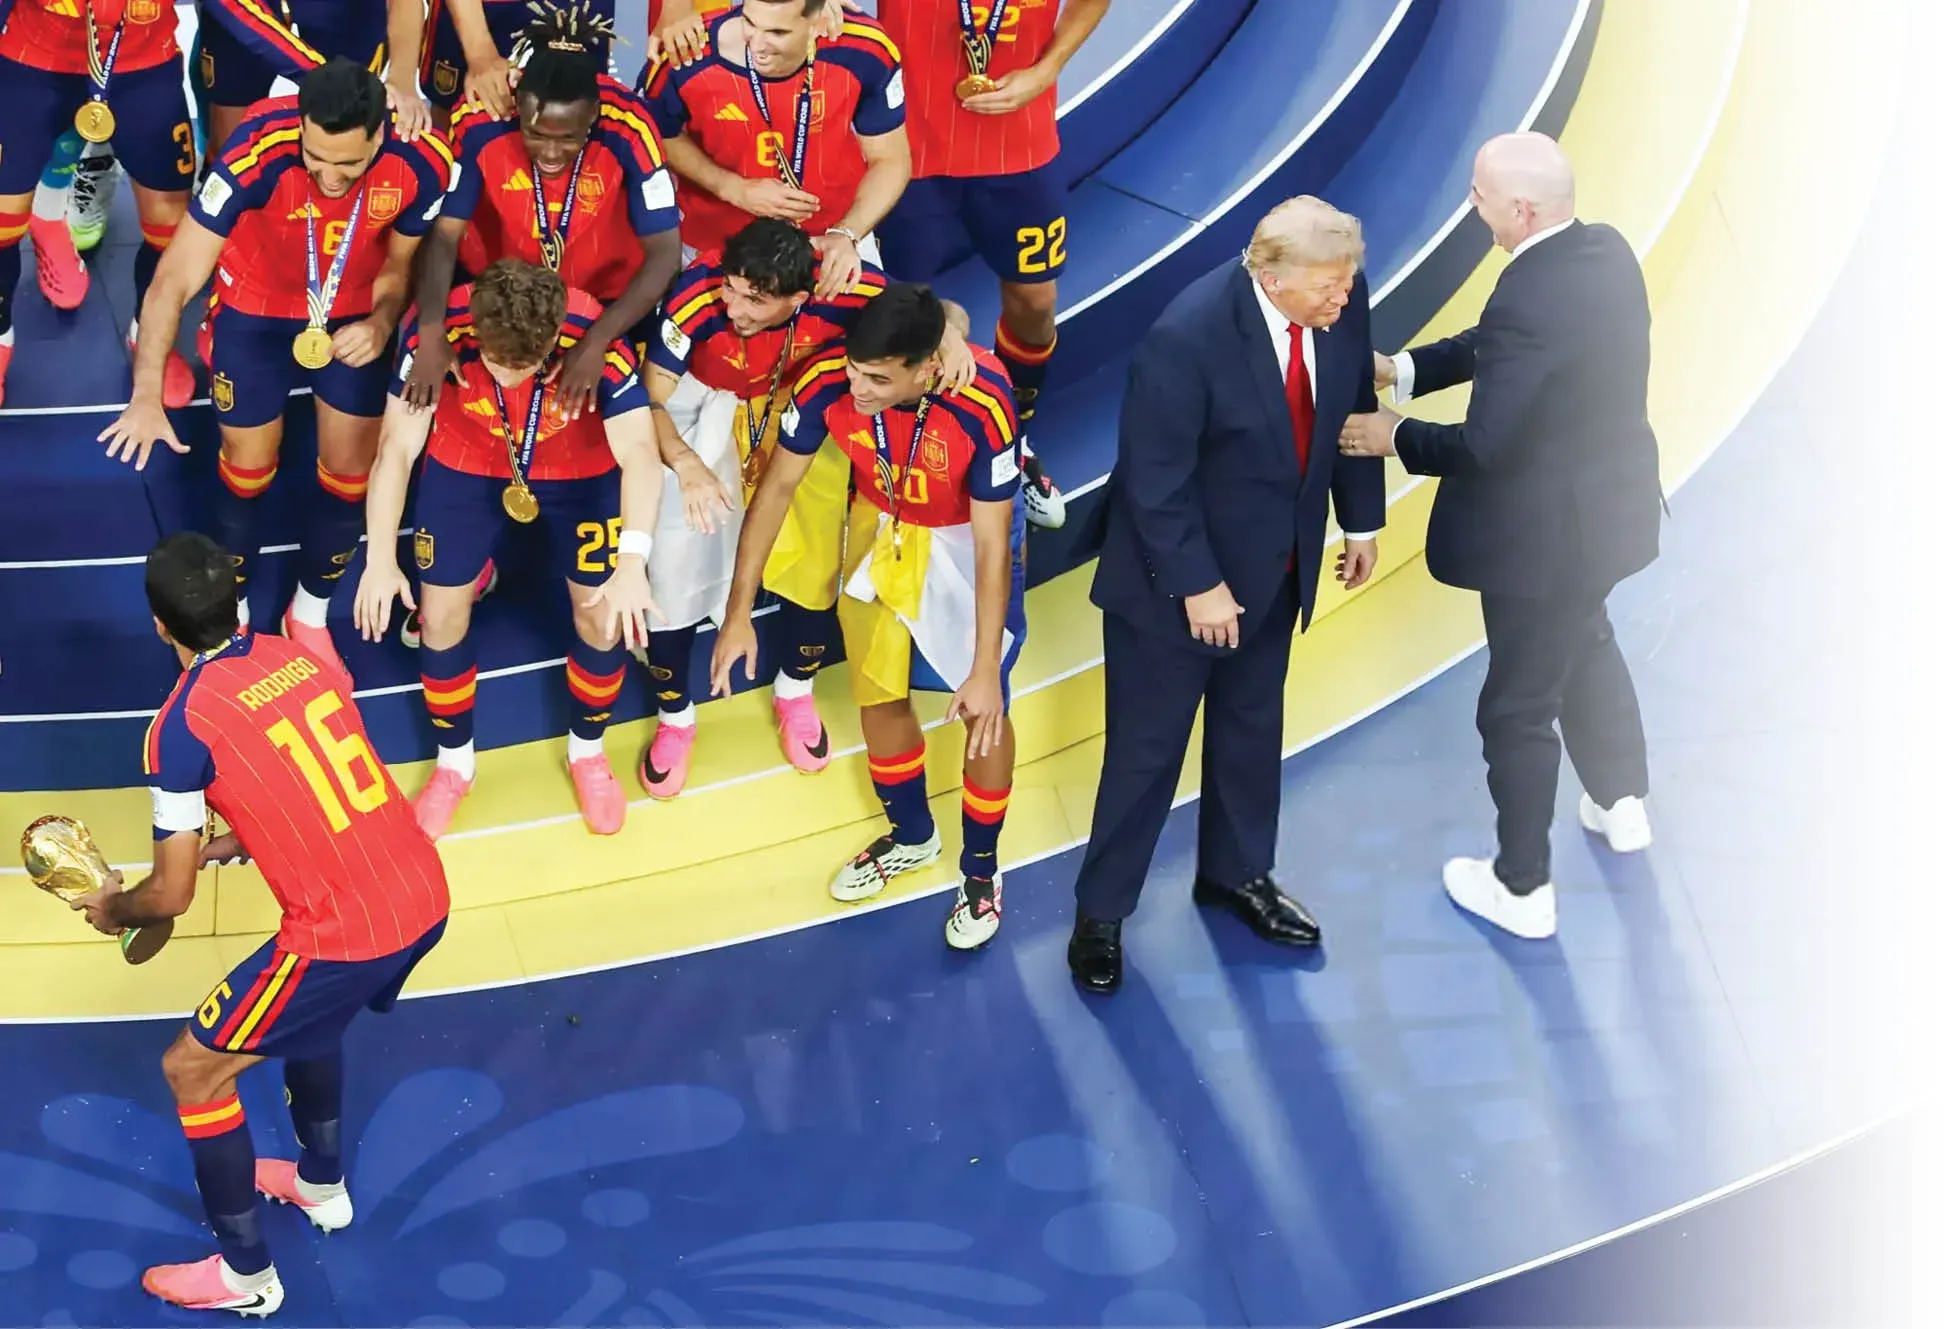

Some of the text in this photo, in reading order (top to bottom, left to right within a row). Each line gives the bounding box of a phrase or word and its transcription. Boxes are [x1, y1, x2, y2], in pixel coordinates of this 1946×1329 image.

[989, 17, 999, 31] FIFA
[104, 55, 115, 72] CUP
[750, 69, 759, 84] CUP
[753, 85, 765, 109] WORLD
[172, 122, 195, 175] 3
[757, 131, 784, 167] 8
[793, 101, 809, 173] FIFA WORLD CUP 2026
[535, 189, 543, 204] CUP
[564, 187, 575, 211] WORLD
[343, 214, 357, 242] WORLD
[560, 211, 570, 226] FIFA
[338, 242, 349, 259] FIFA
[1017, 216, 1066, 273] 22
[528, 413, 538, 427] CUP
[524, 427, 535, 451] WORLD
[876, 425, 887, 449] 2026
[522, 450, 531, 465] FIFA
[577, 517, 622, 572] 25
[236, 656, 320, 712] RODRIGO
[265, 690, 389, 834] 16
